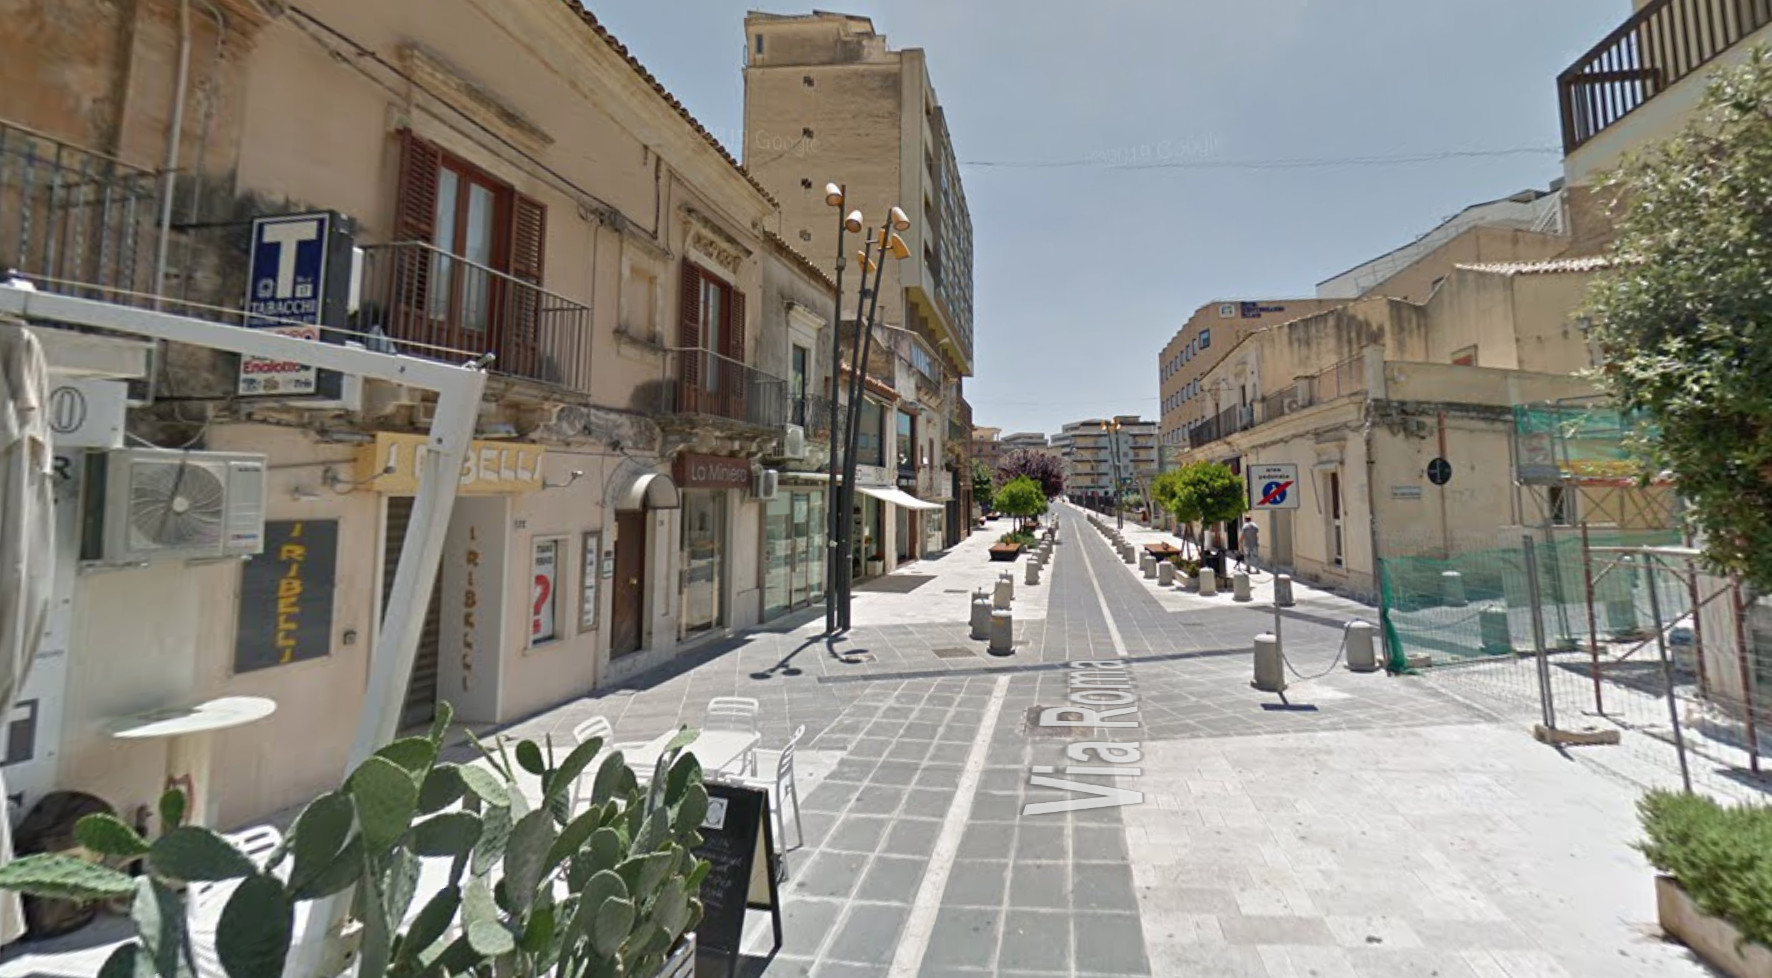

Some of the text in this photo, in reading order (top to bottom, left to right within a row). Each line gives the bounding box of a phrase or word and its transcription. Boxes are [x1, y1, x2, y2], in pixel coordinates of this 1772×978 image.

[263, 220, 318, 299] T
[251, 300, 317, 316] TABACCHI
[414, 443, 543, 485] RBELLI
[691, 460, 747, 482] La Miniera
